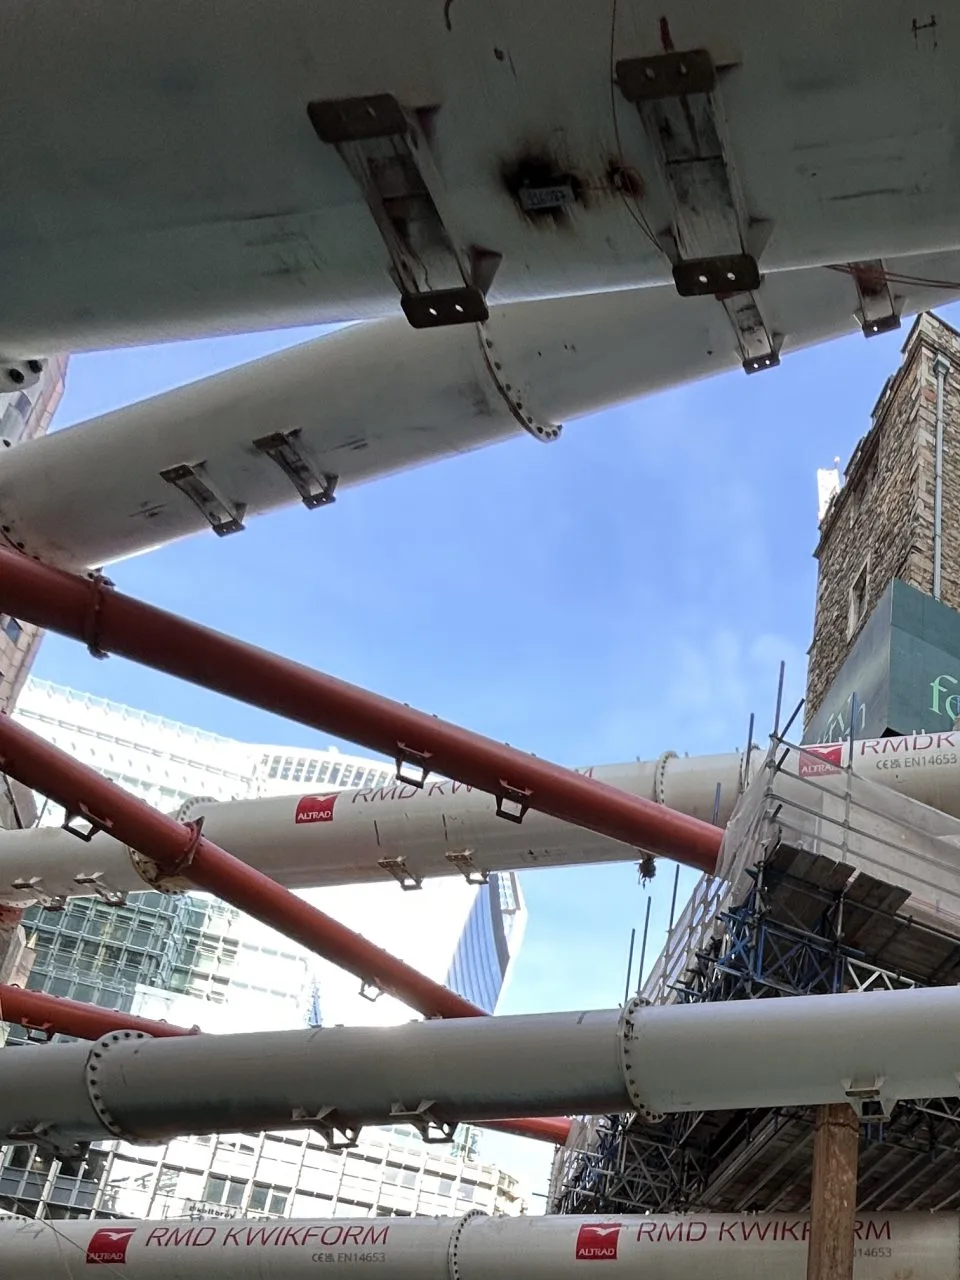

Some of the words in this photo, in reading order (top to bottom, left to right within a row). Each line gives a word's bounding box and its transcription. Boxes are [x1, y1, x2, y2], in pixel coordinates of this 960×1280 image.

[861, 732, 956, 756] RMDK
[904, 754, 957, 769] EN14653
[351, 785, 418, 804] RMD
[297, 809, 332, 822] ALTRAD
[145, 1226, 216, 1247] RMD
[223, 1225, 389, 1247] KWIKFORM
[636, 1220, 708, 1243] RMD
[88, 1251, 123, 1262] ALTRAD
[337, 1251, 386, 1264] EN14653
[578, 1247, 616, 1258] ALTRAD
